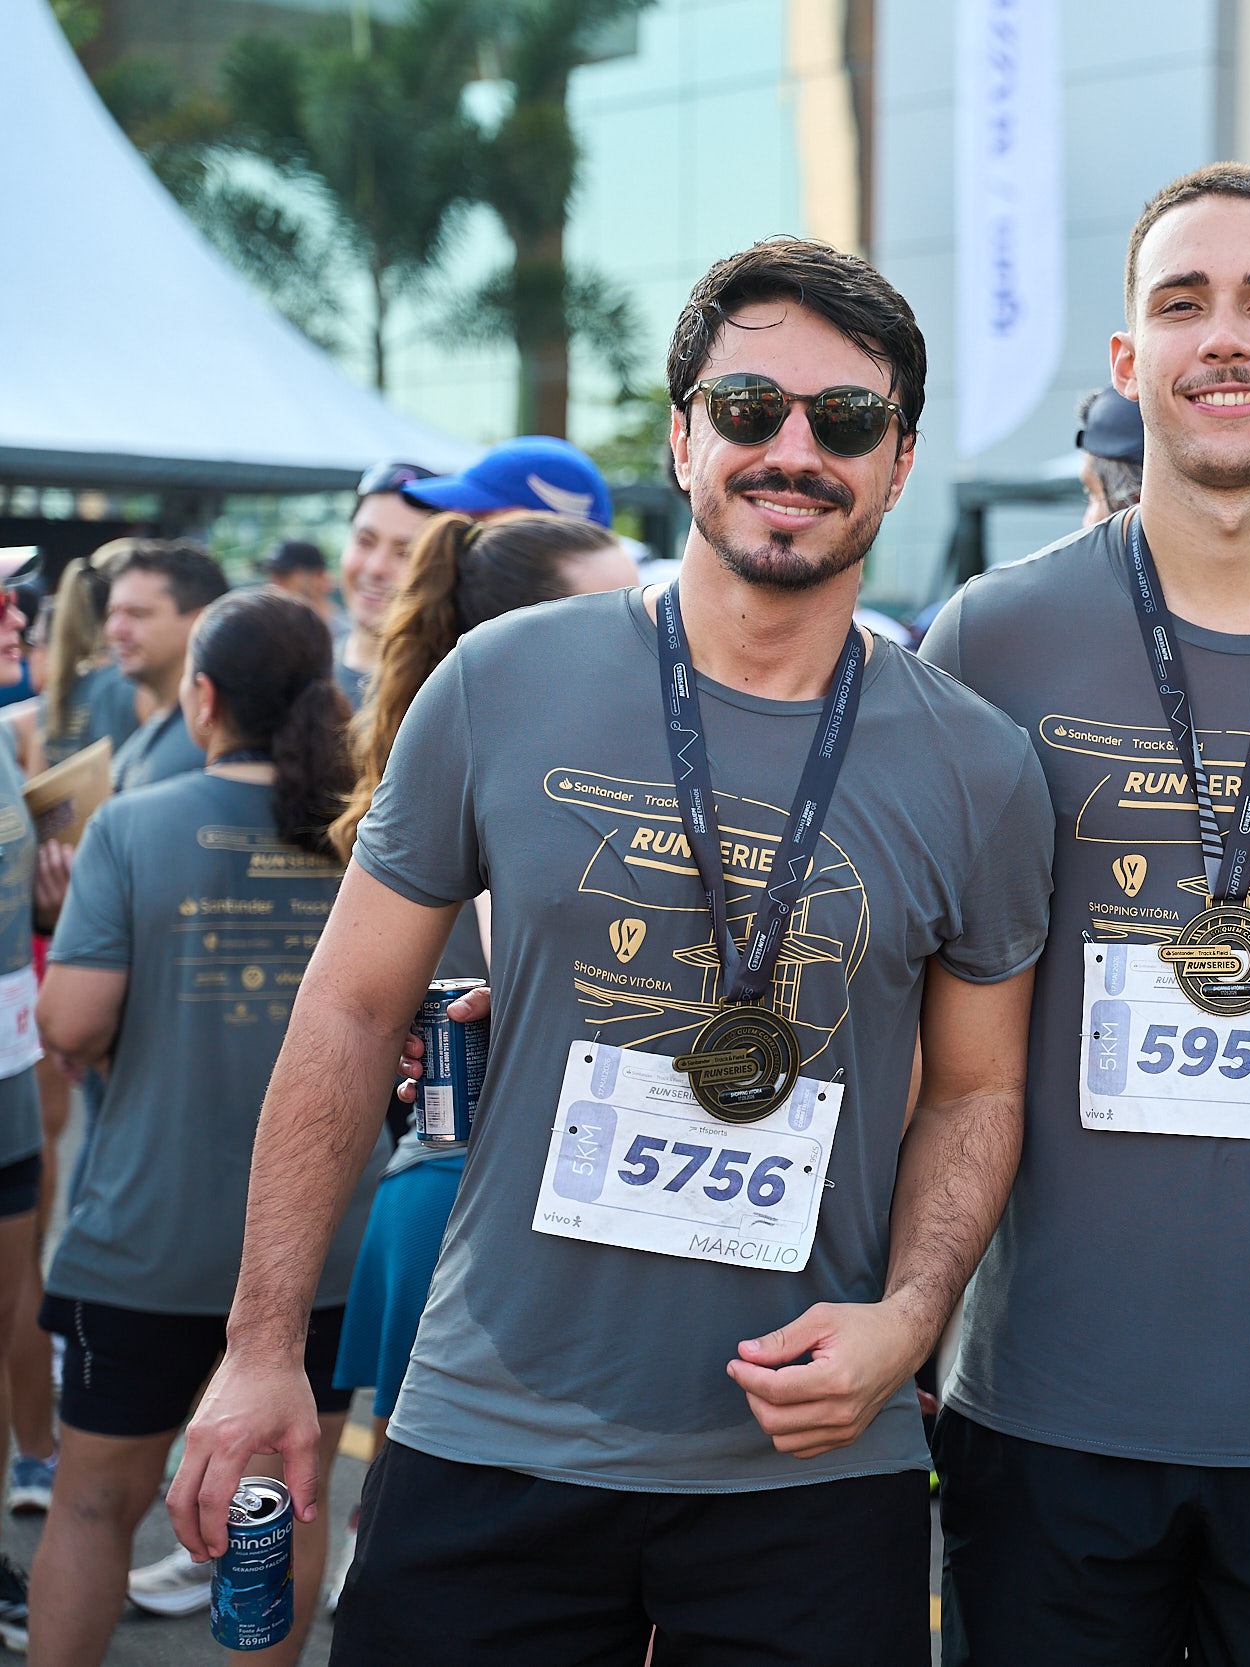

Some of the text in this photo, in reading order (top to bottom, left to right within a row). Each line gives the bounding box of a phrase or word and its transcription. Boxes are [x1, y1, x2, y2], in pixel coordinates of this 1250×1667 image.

[1132, 542, 1144, 571] CORRE
[1137, 571, 1150, 598] QUEM
[1143, 600, 1154, 613] SÓ
[665, 607, 675, 634] QUEM
[668, 635, 678, 649] SÓ
[822, 644, 860, 759] SÓ QUEM CORRE ENTENDE
[1068, 728, 1123, 747] Santander
[574, 782, 634, 802] Santander
[630, 827, 776, 872] RUNERIE
[1229, 865, 1243, 895] QUEM
[1088, 901, 1179, 920] SHOPPING VITÓRIA
[1222, 926, 1242, 934] QUEM
[1187, 961, 1236, 970] RUNSERIES
[574, 960, 672, 992] SHOPPING VITÓRIA
[737, 1028, 757, 1036] QUEM
[1099, 1021, 1118, 1071] 5KM
[703, 1064, 753, 1079] RUNSERIES
[649, 1086, 697, 1100] RUNSERIE
[1085, 1108, 1105, 1120] vivo
[699, 1126, 728, 1137] tfsports
[572, 1124, 602, 1176] 5KM
[617, 1134, 794, 1207] 5756
[543, 1211, 572, 1226] vivo
[689, 1233, 799, 1265] MARCILIO
[232, 1565, 264, 1573] GERANDO
[238, 1634, 271, 1646] 269ml
